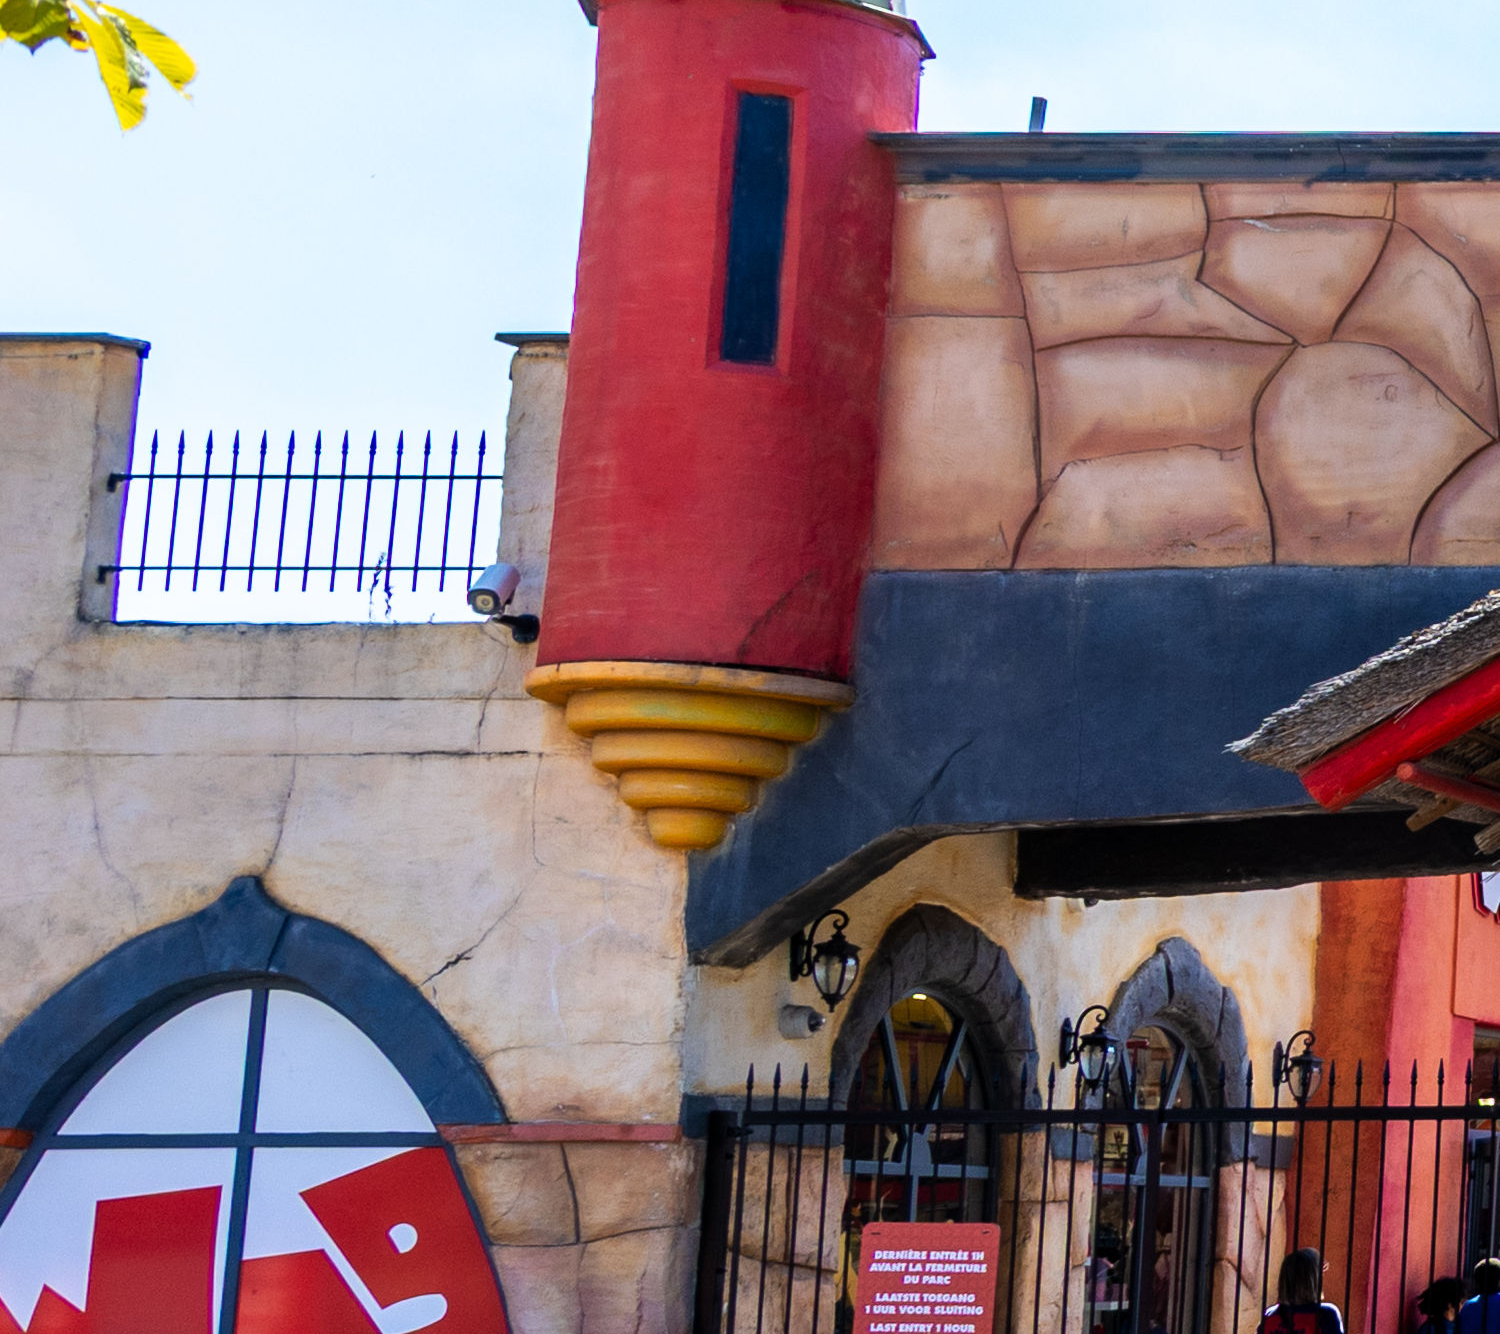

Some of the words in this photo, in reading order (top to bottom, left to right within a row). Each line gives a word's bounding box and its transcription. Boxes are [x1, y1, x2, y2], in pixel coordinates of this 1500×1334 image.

[929, 1248, 969, 1261] ENTRÉE
[971, 1250, 985, 1261] 1H
[869, 1262, 907, 1272] AVANT
[908, 1262, 923, 1272] LA
[925, 1262, 988, 1273] FERMETURE
[903, 1274, 920, 1285] DU
[921, 1274, 952, 1285] PARC
[875, 1292, 921, 1303] LAATSTE
[922, 1293, 976, 1303] TOEGANG
[872, 1304, 896, 1315] UUR
[898, 1305, 931, 1315] VOOR
[870, 1322, 897, 1333] LAST
[898, 1323, 934, 1333] ENTRY
[943, 1323, 976, 1333] HOUR
